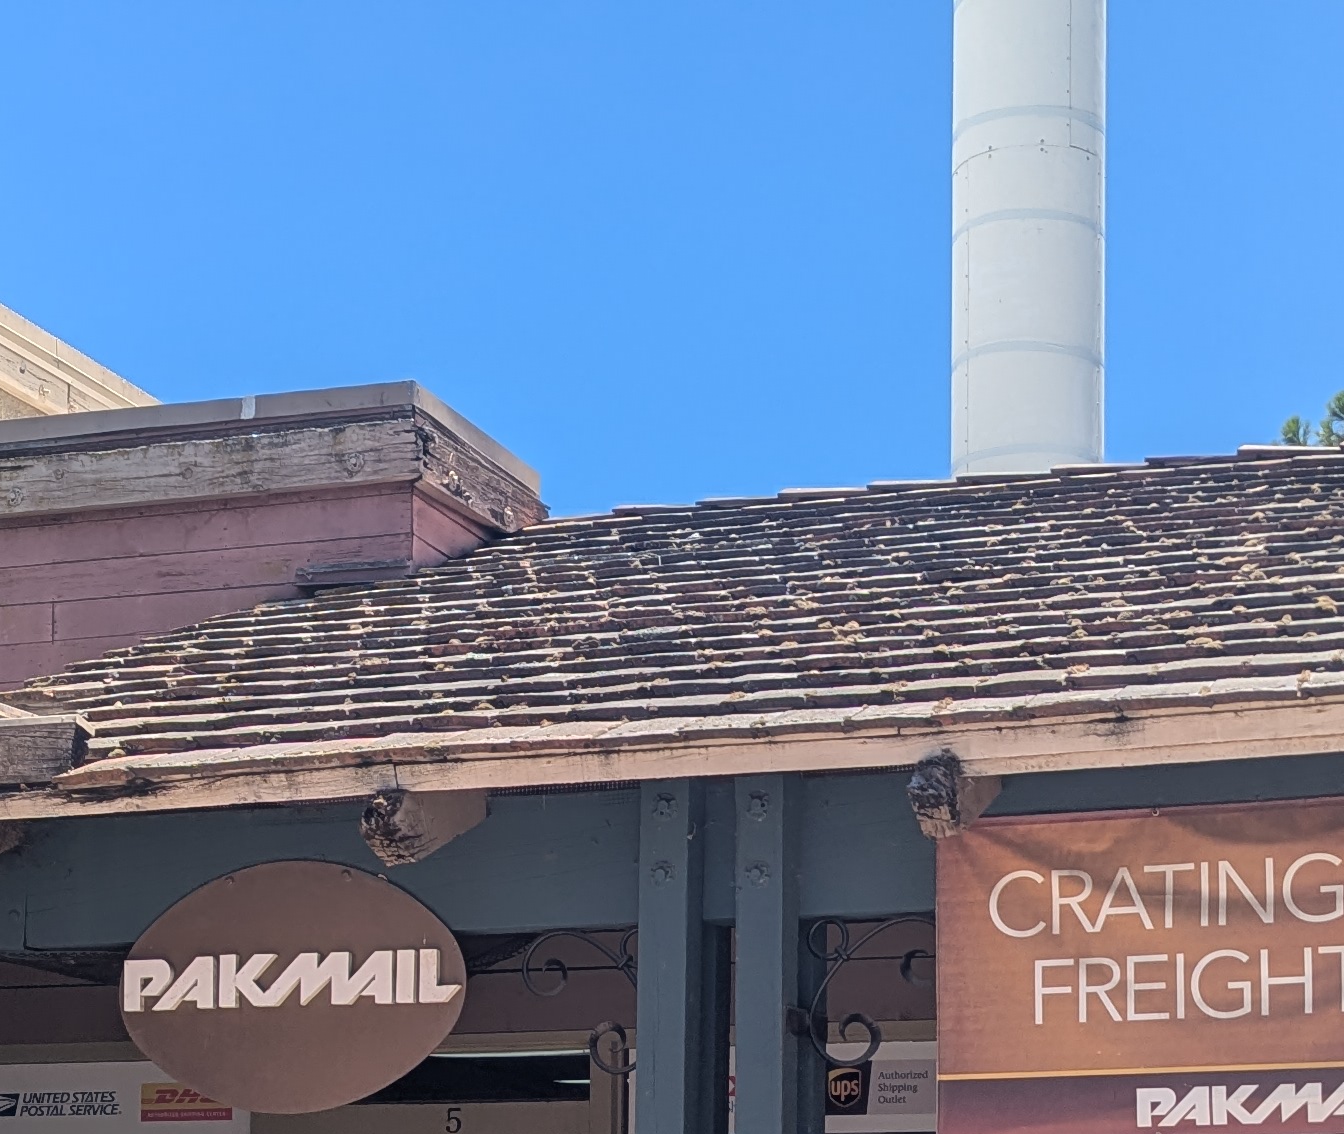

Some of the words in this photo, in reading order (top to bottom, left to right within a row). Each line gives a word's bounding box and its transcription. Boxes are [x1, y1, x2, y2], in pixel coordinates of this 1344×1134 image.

[989, 852, 1344, 938] CRATING
[123, 948, 462, 1012] PAKMAIL
[878, 1070, 928, 1081] Authorized
[830, 1079, 859, 1102] ups
[878, 1083, 918, 1093] Shipping
[22, 1092, 70, 1104] UNITED
[72, 1091, 116, 1103] STATES
[878, 1095, 906, 1104] Outlet
[20, 1104, 68, 1117] POSTAL
[445, 1107, 462, 1133] 5
